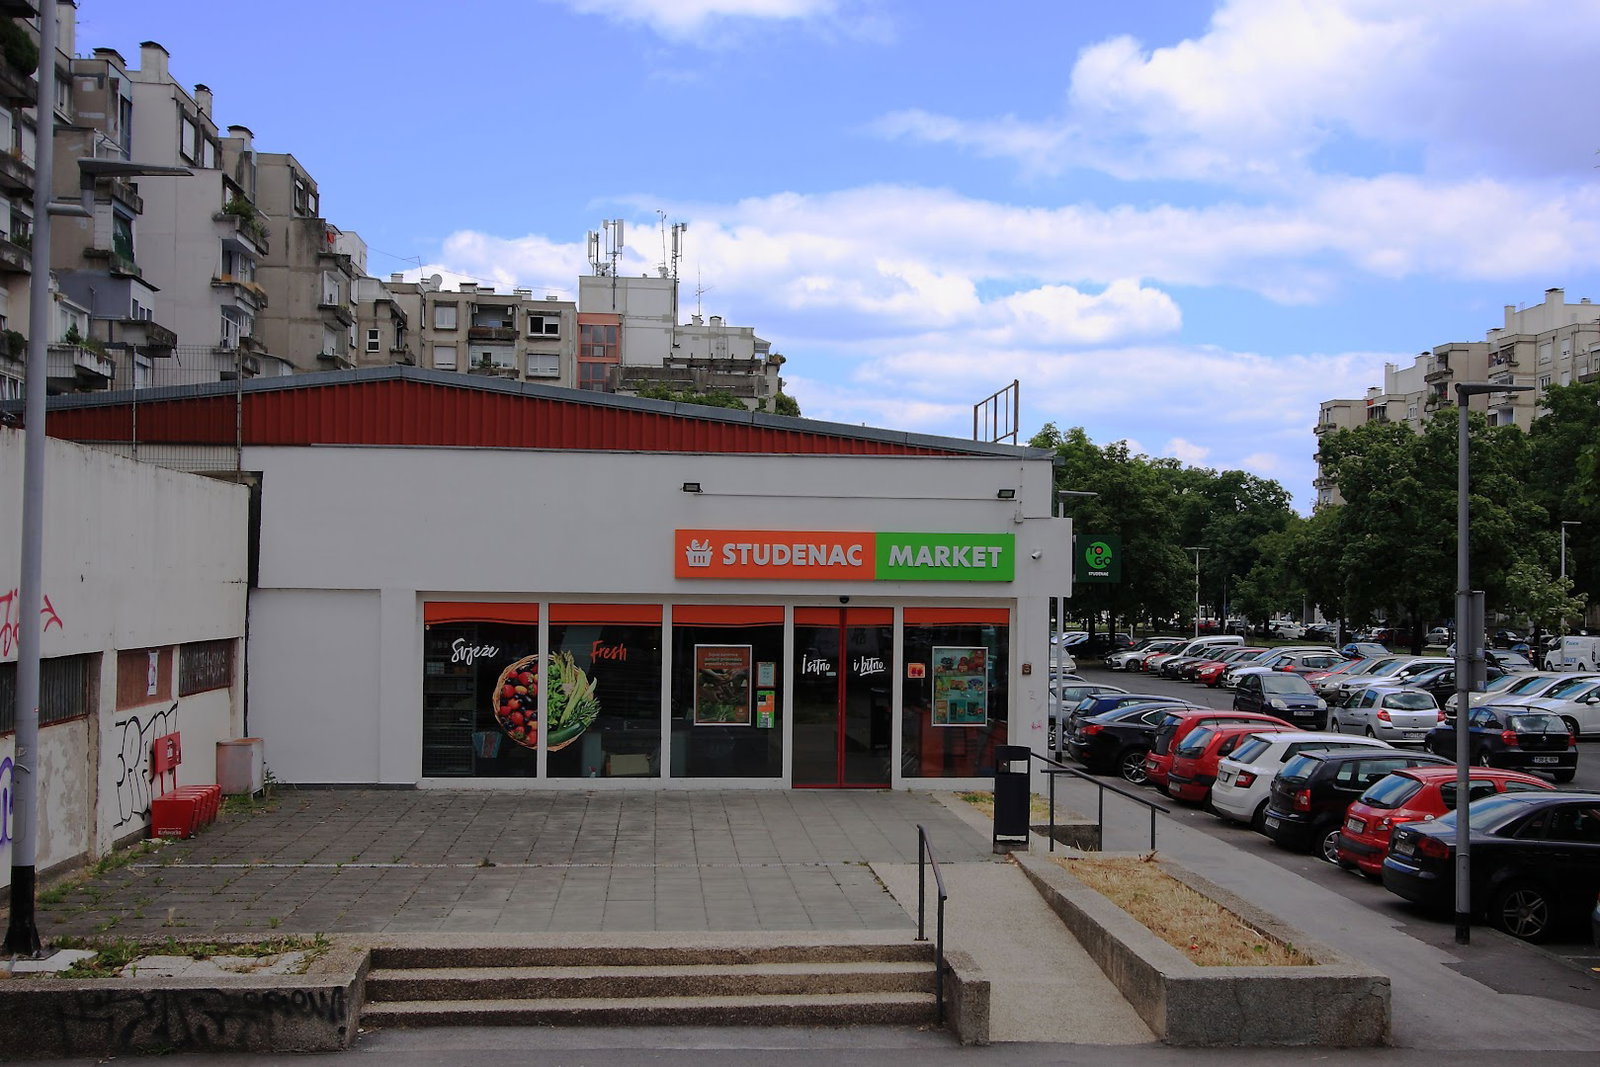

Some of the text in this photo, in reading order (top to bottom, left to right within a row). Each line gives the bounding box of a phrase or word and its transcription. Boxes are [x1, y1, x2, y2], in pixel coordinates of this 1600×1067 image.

[722, 544, 1003, 568] STUDENAC MARKET
[1088, 546, 1103, 555] TO
[1095, 556, 1112, 566] GO
[451, 638, 500, 666] Svježe
[590, 640, 628, 664] Fresh
